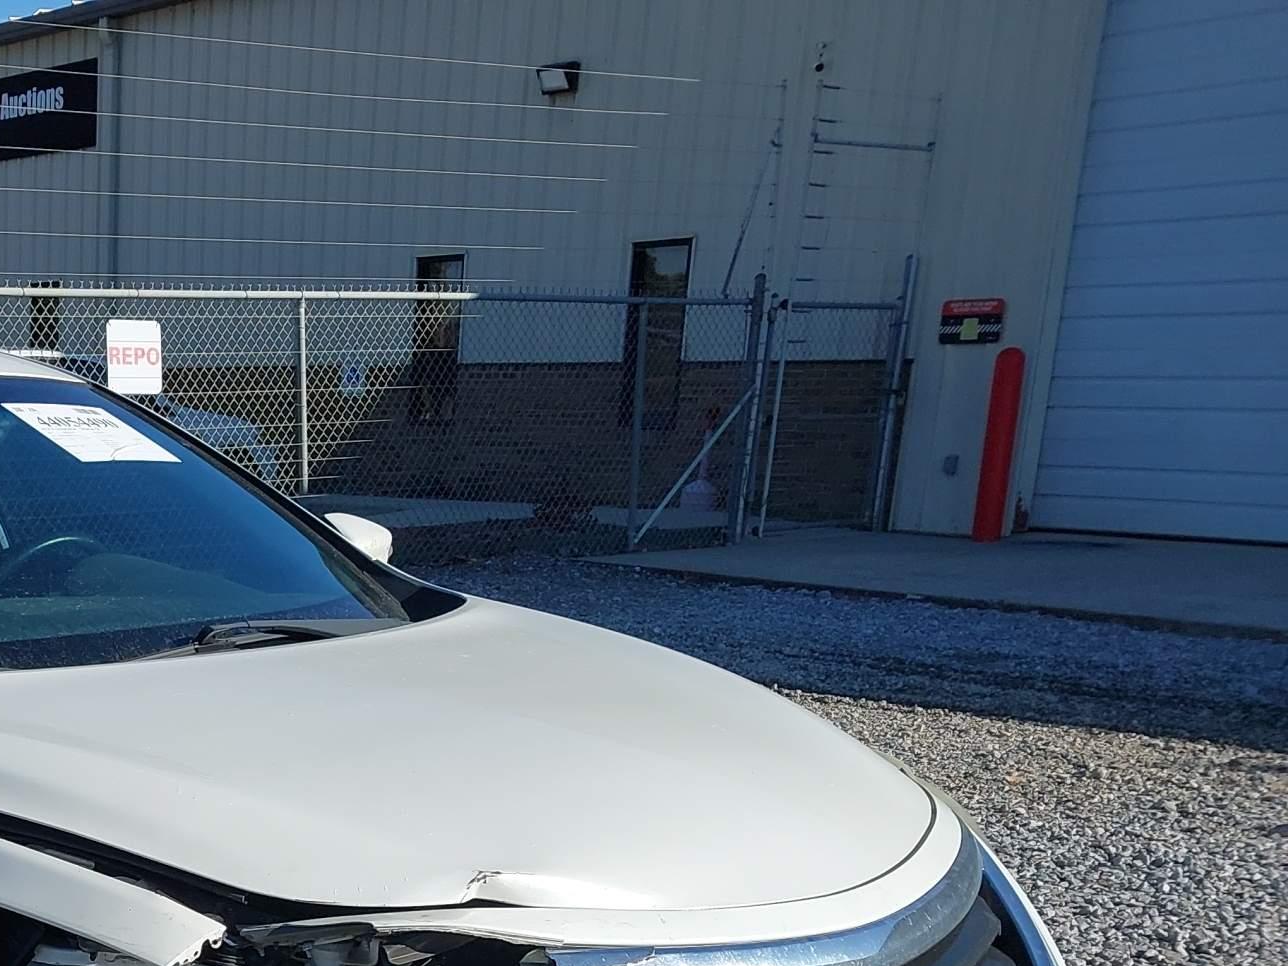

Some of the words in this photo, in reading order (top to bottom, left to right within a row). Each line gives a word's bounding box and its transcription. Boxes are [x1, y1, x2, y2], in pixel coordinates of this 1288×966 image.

[0, 86, 64, 121] Auctions
[108, 346, 160, 366] REPO
[36, 416, 120, 429] 44054490
